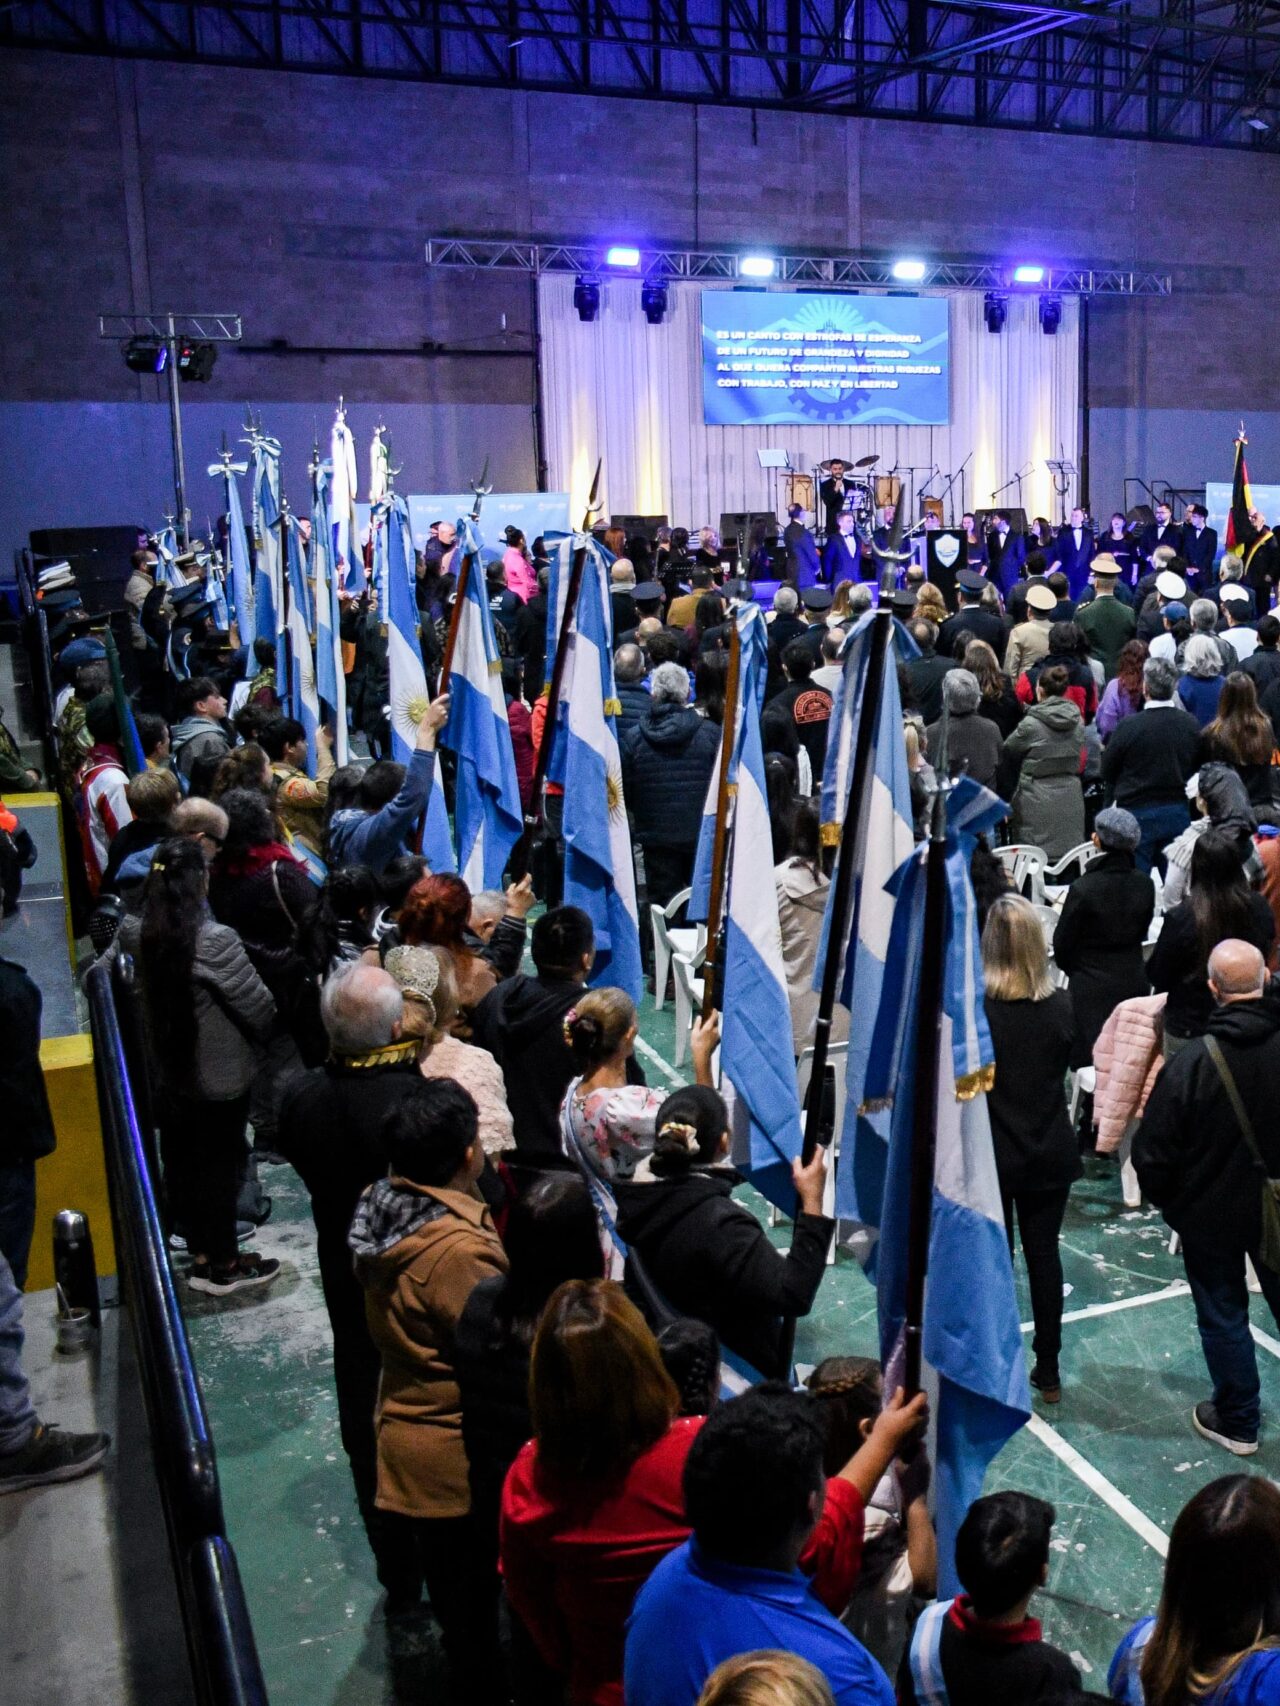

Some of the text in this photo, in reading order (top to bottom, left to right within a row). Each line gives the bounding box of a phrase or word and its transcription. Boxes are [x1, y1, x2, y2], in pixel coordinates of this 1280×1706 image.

[731, 331, 746, 339] UN
[747, 332, 781, 340] CANTO
[783, 332, 804, 340] CON
[804, 332, 853, 342] ESTROFAS
[868, 334, 922, 343] ESPERANZA
[716, 347, 730, 356] DE
[748, 348, 788, 356] FUTURO
[788, 348, 802, 356] DE
[804, 348, 856, 358] GRANDEZA
[716, 363, 731, 372] AL
[792, 364, 846, 373] COMPARTIR
[847, 365, 895, 374] NUESTRAS
[717, 378, 740, 387] CON
[741, 378, 788, 388] TRABAJO,
[789, 379, 811, 388] CON
[854, 380, 899, 389] LIBERTAD
